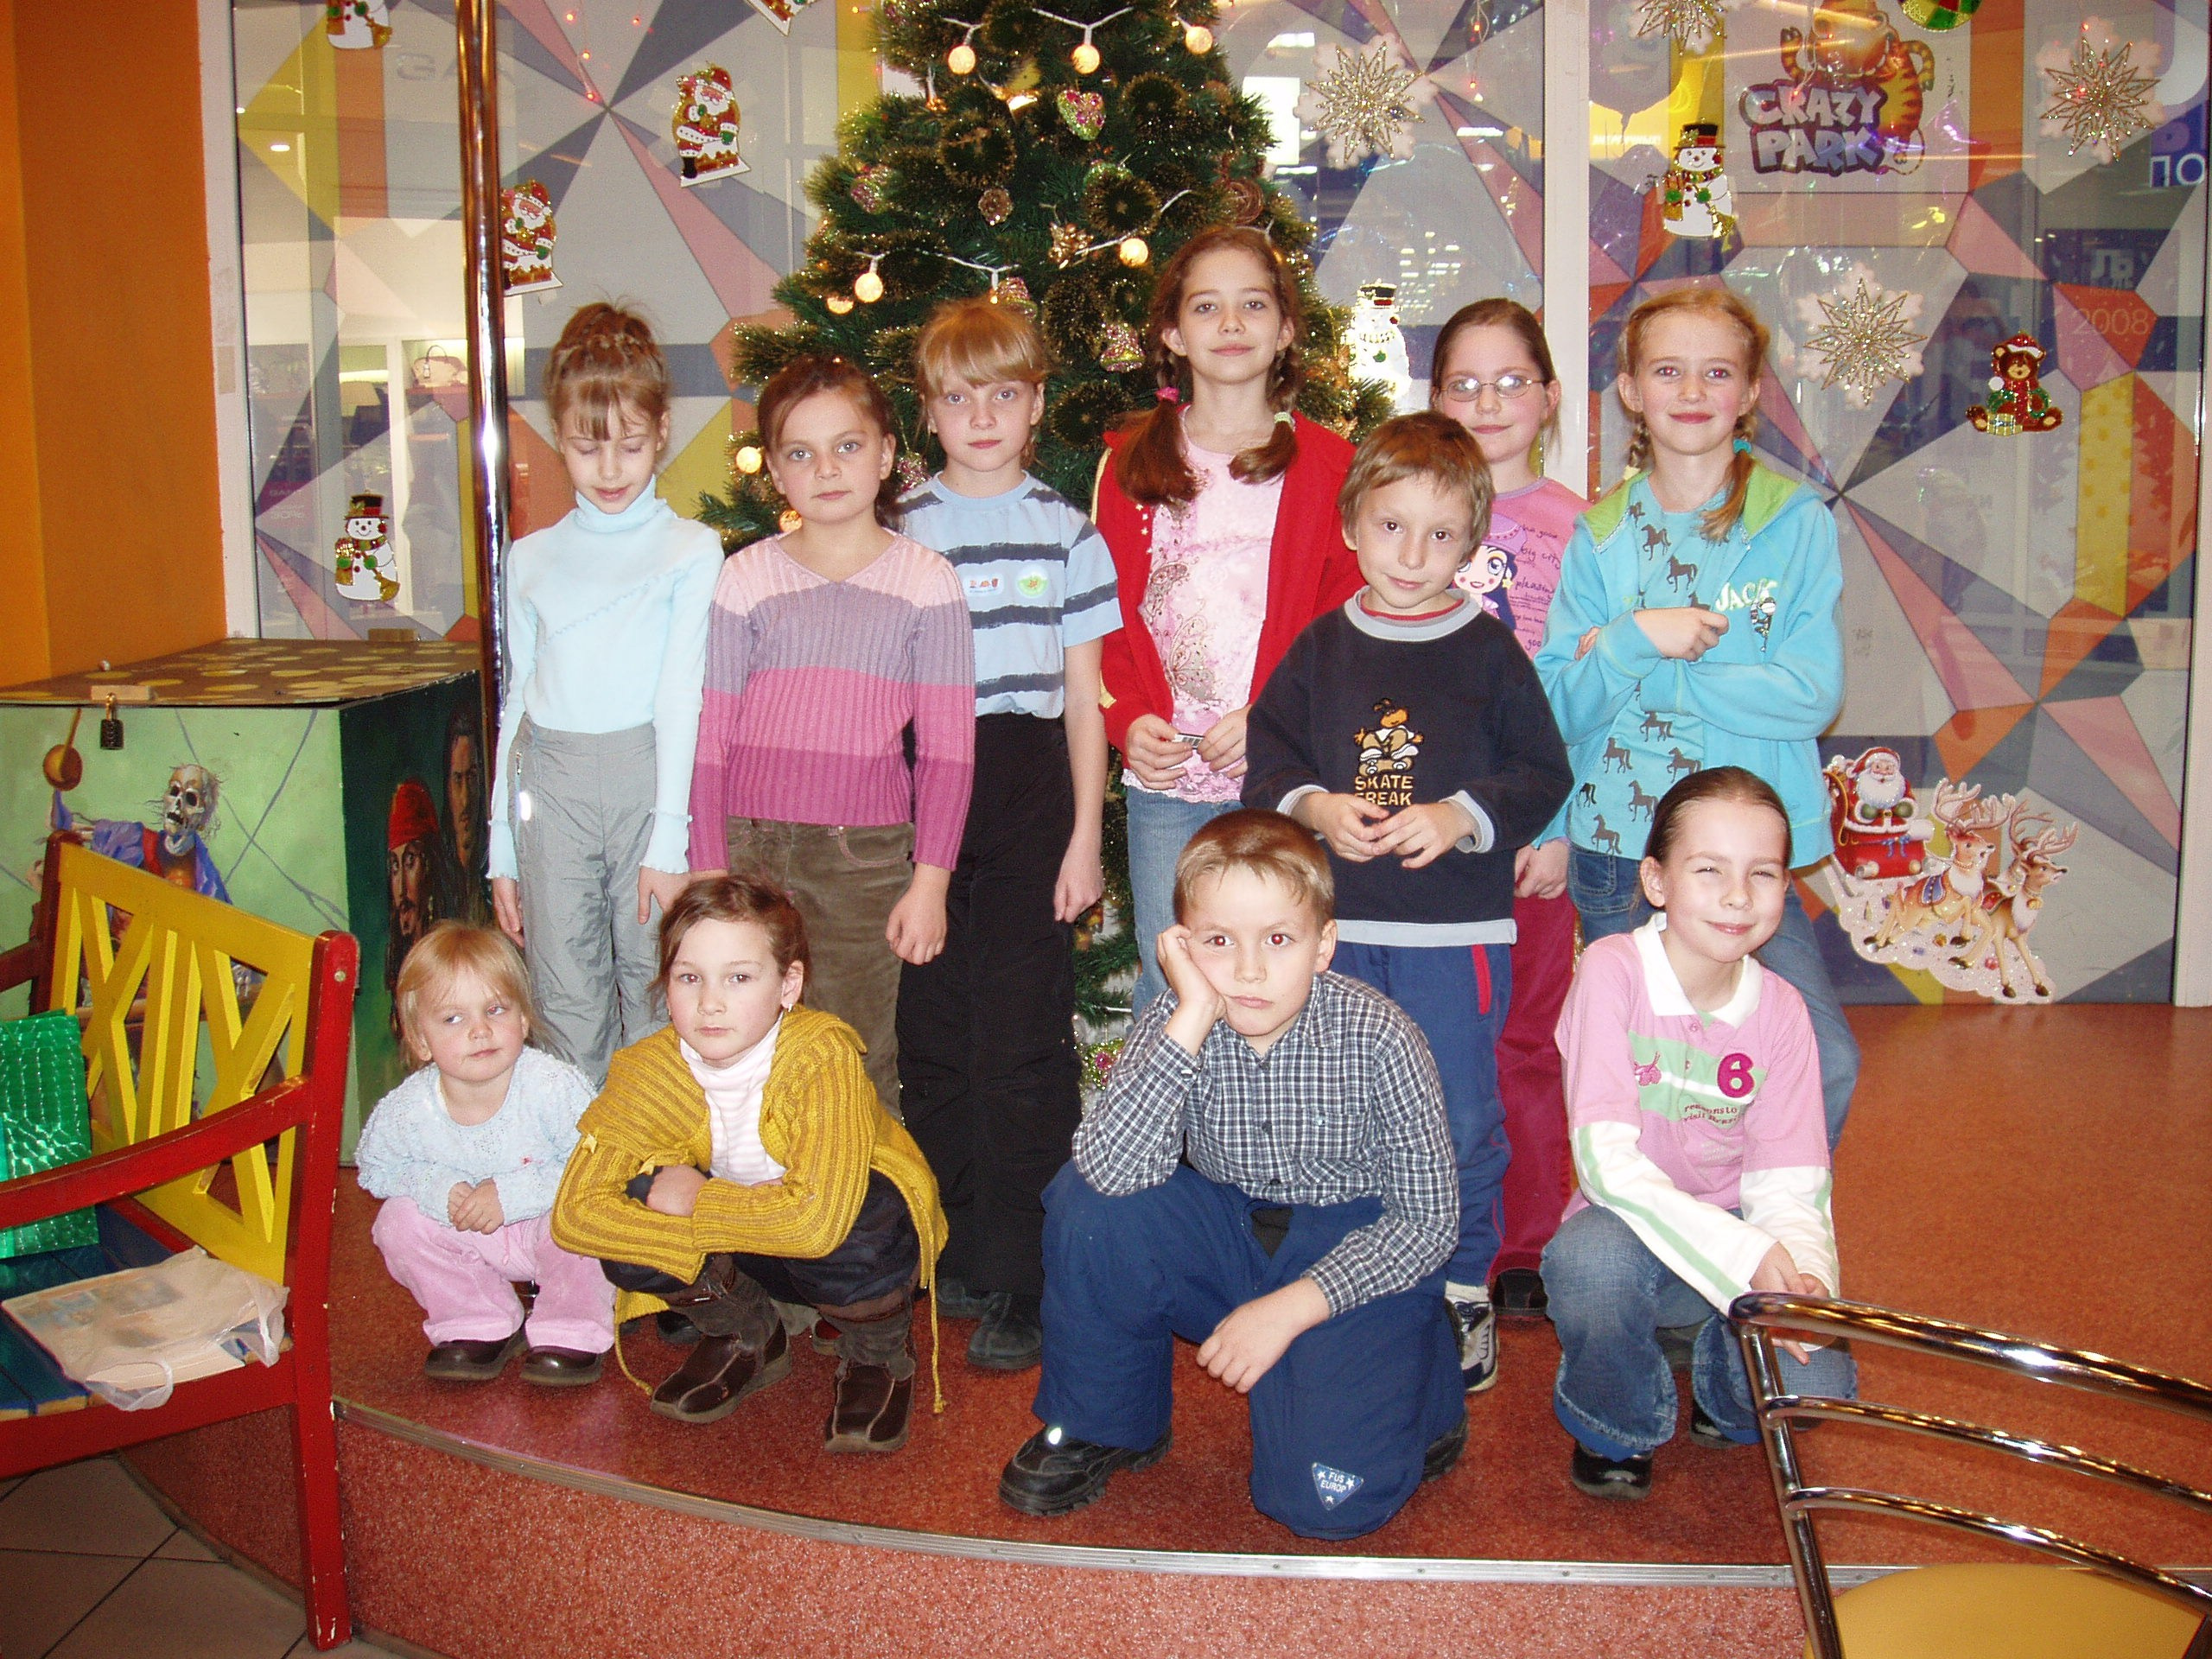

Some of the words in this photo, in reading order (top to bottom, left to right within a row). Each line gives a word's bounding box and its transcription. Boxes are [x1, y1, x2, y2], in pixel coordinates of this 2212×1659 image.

[1744, 85, 1882, 127] CRAZY
[1756, 126, 1879, 170] PARK
[2072, 308, 2150, 335] 2008
[1715, 578, 1778, 612] JACK
[1354, 774, 1414, 791] SKATE
[1717, 1052, 1756, 1098] 6
